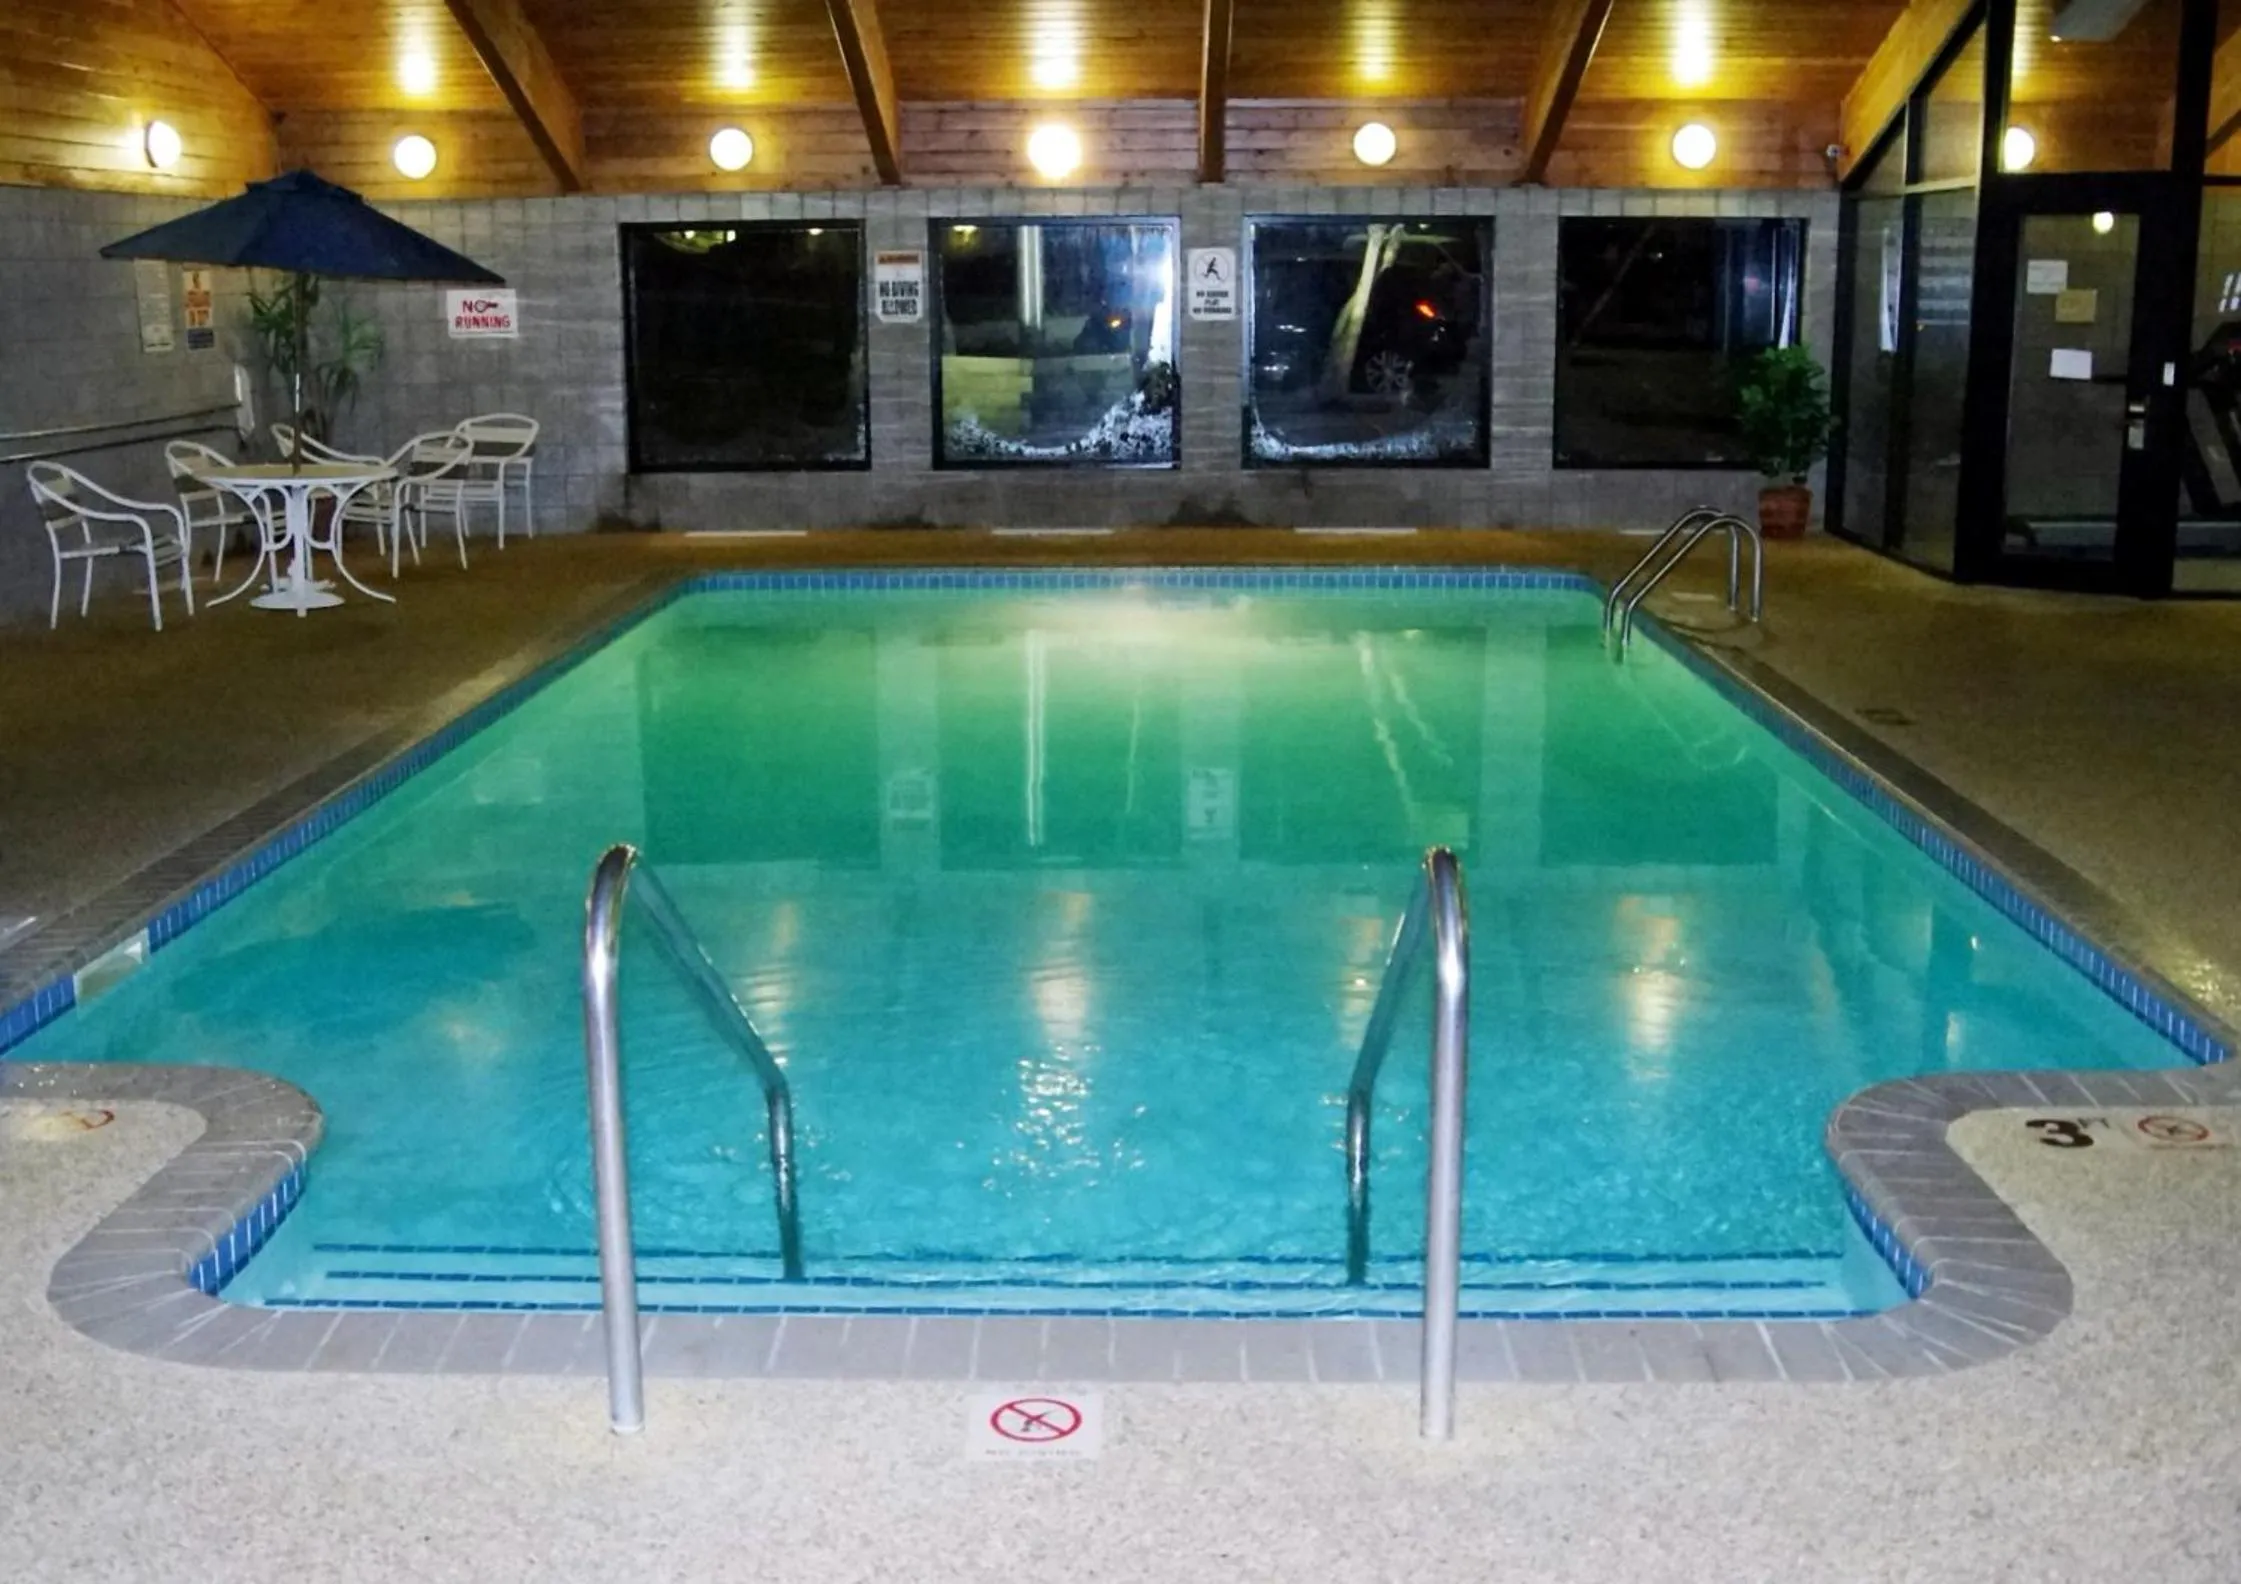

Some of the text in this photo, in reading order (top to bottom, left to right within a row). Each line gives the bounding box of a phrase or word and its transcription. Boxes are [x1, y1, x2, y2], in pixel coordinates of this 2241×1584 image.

[462, 299, 487, 313] NO
[455, 315, 511, 329] RUNNING
[2025, 1118, 2094, 1148] 3
